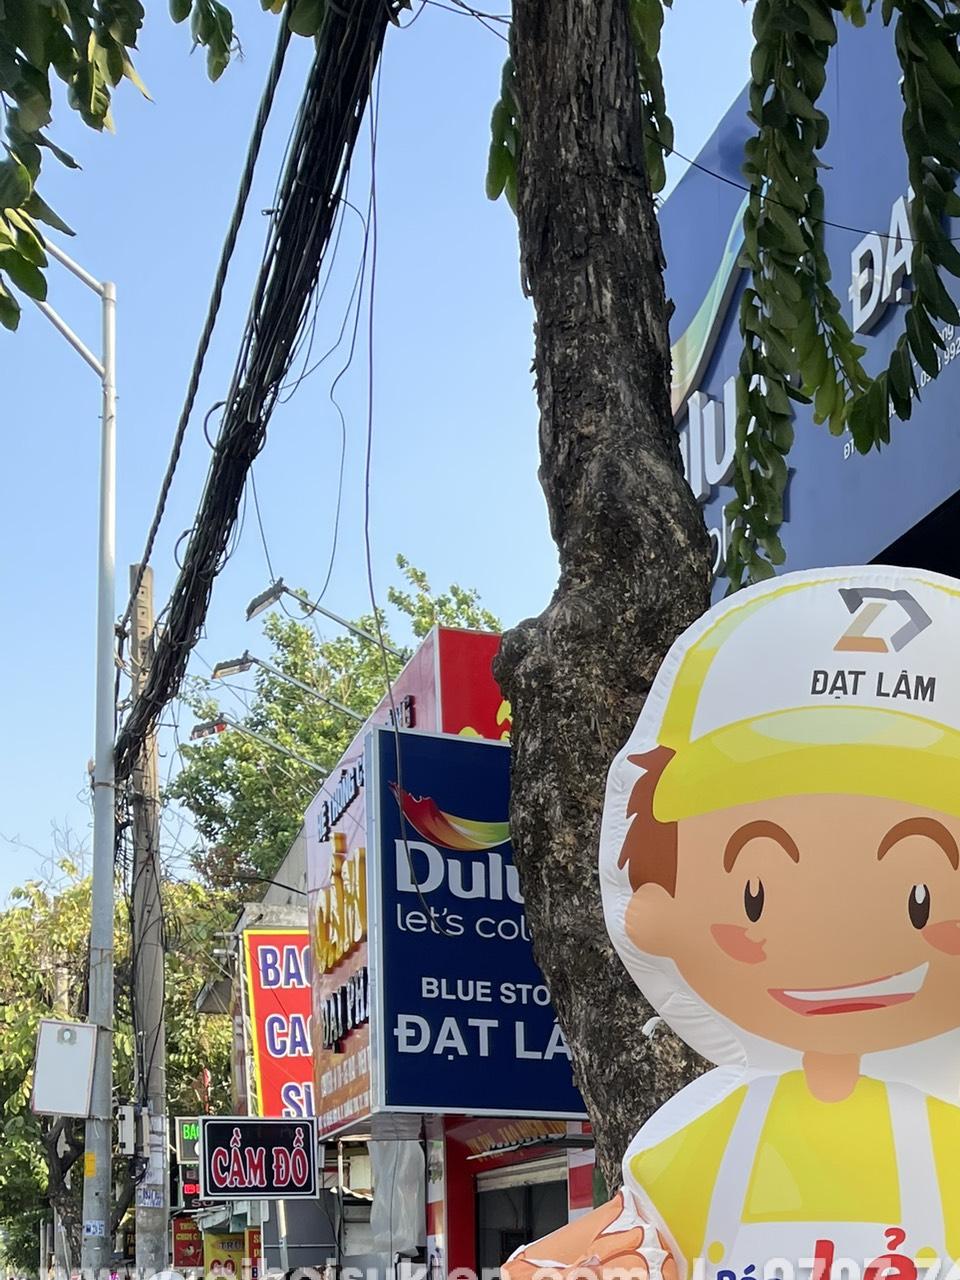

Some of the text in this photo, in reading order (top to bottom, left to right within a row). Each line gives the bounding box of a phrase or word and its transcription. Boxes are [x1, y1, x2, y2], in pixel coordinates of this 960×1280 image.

[848, 186, 918, 336] ĐẠ
[810, 669, 937, 702] ĐẠT LÂM
[421, 976, 492, 1003] BLUE
[394, 1014, 499, 1062] ĐẠT
